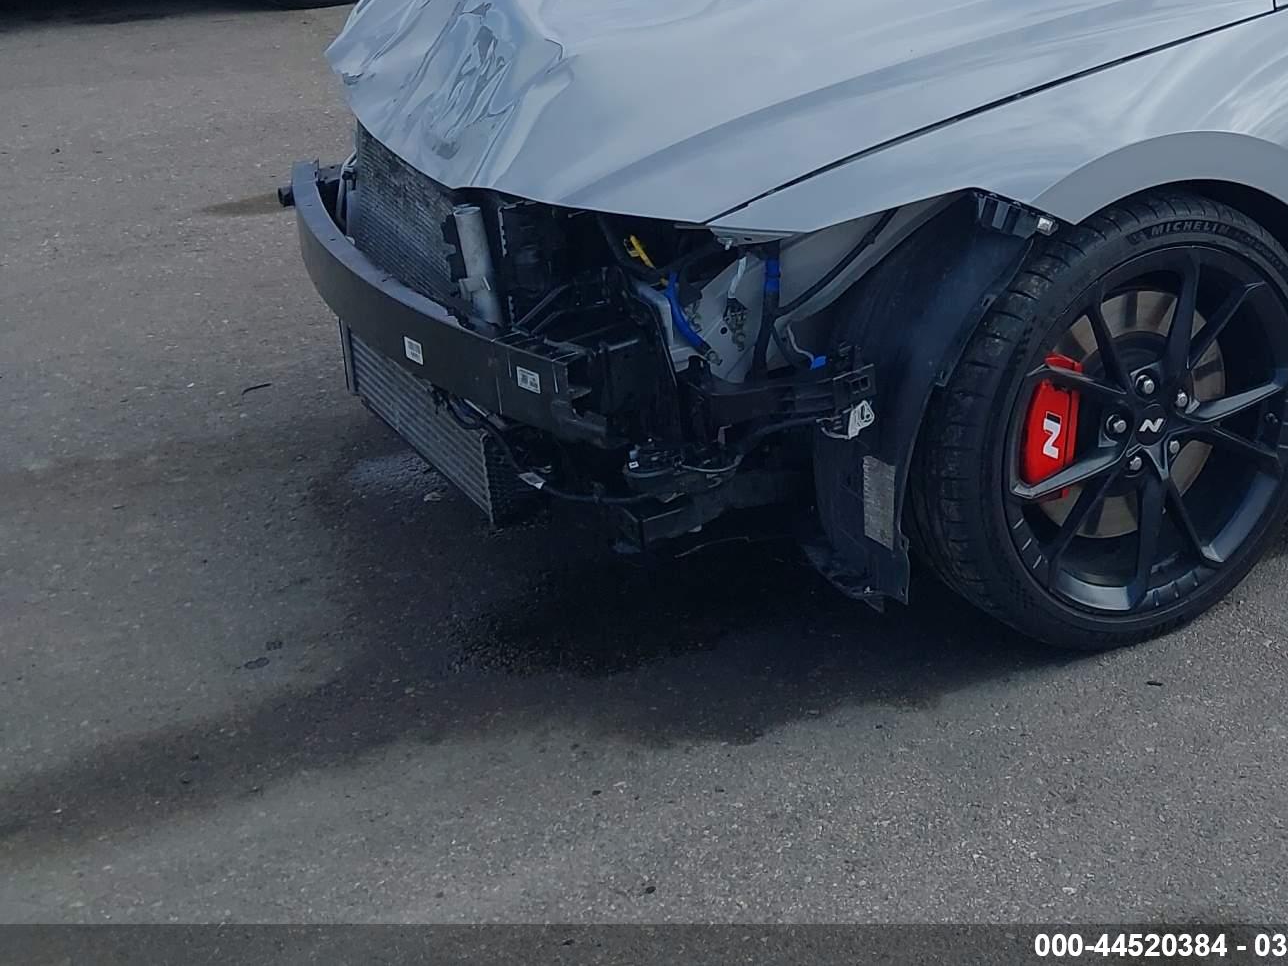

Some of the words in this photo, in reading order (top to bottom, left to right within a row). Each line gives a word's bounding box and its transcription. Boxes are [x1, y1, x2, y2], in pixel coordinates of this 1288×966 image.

[1152, 221, 1231, 236] MICHELIN
[1139, 418, 1164, 432] N
[1042, 411, 1063, 459] N
